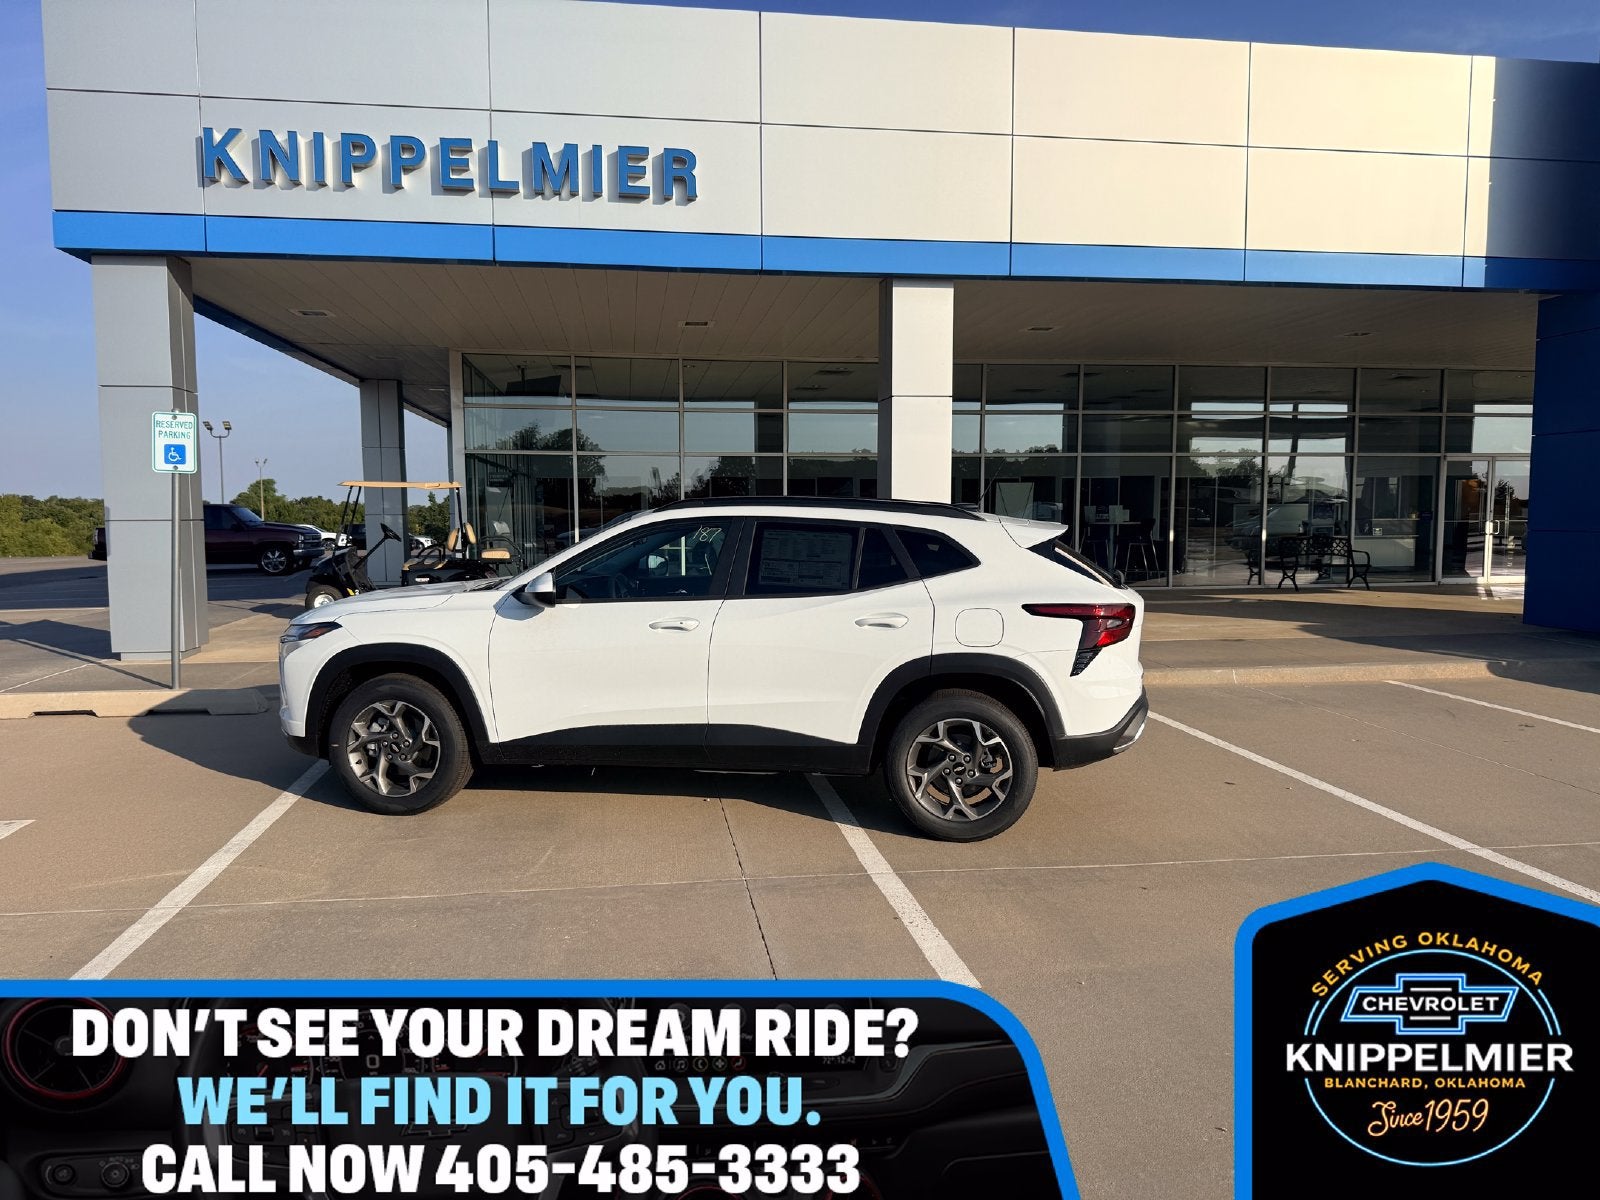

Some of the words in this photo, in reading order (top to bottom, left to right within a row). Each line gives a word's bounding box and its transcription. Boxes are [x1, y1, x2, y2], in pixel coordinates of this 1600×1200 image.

[202, 126, 698, 201] KNIPPELMIER
[155, 420, 193, 429] RESERVED
[158, 430, 191, 439] PARKING
[693, 524, 723, 544] 187
